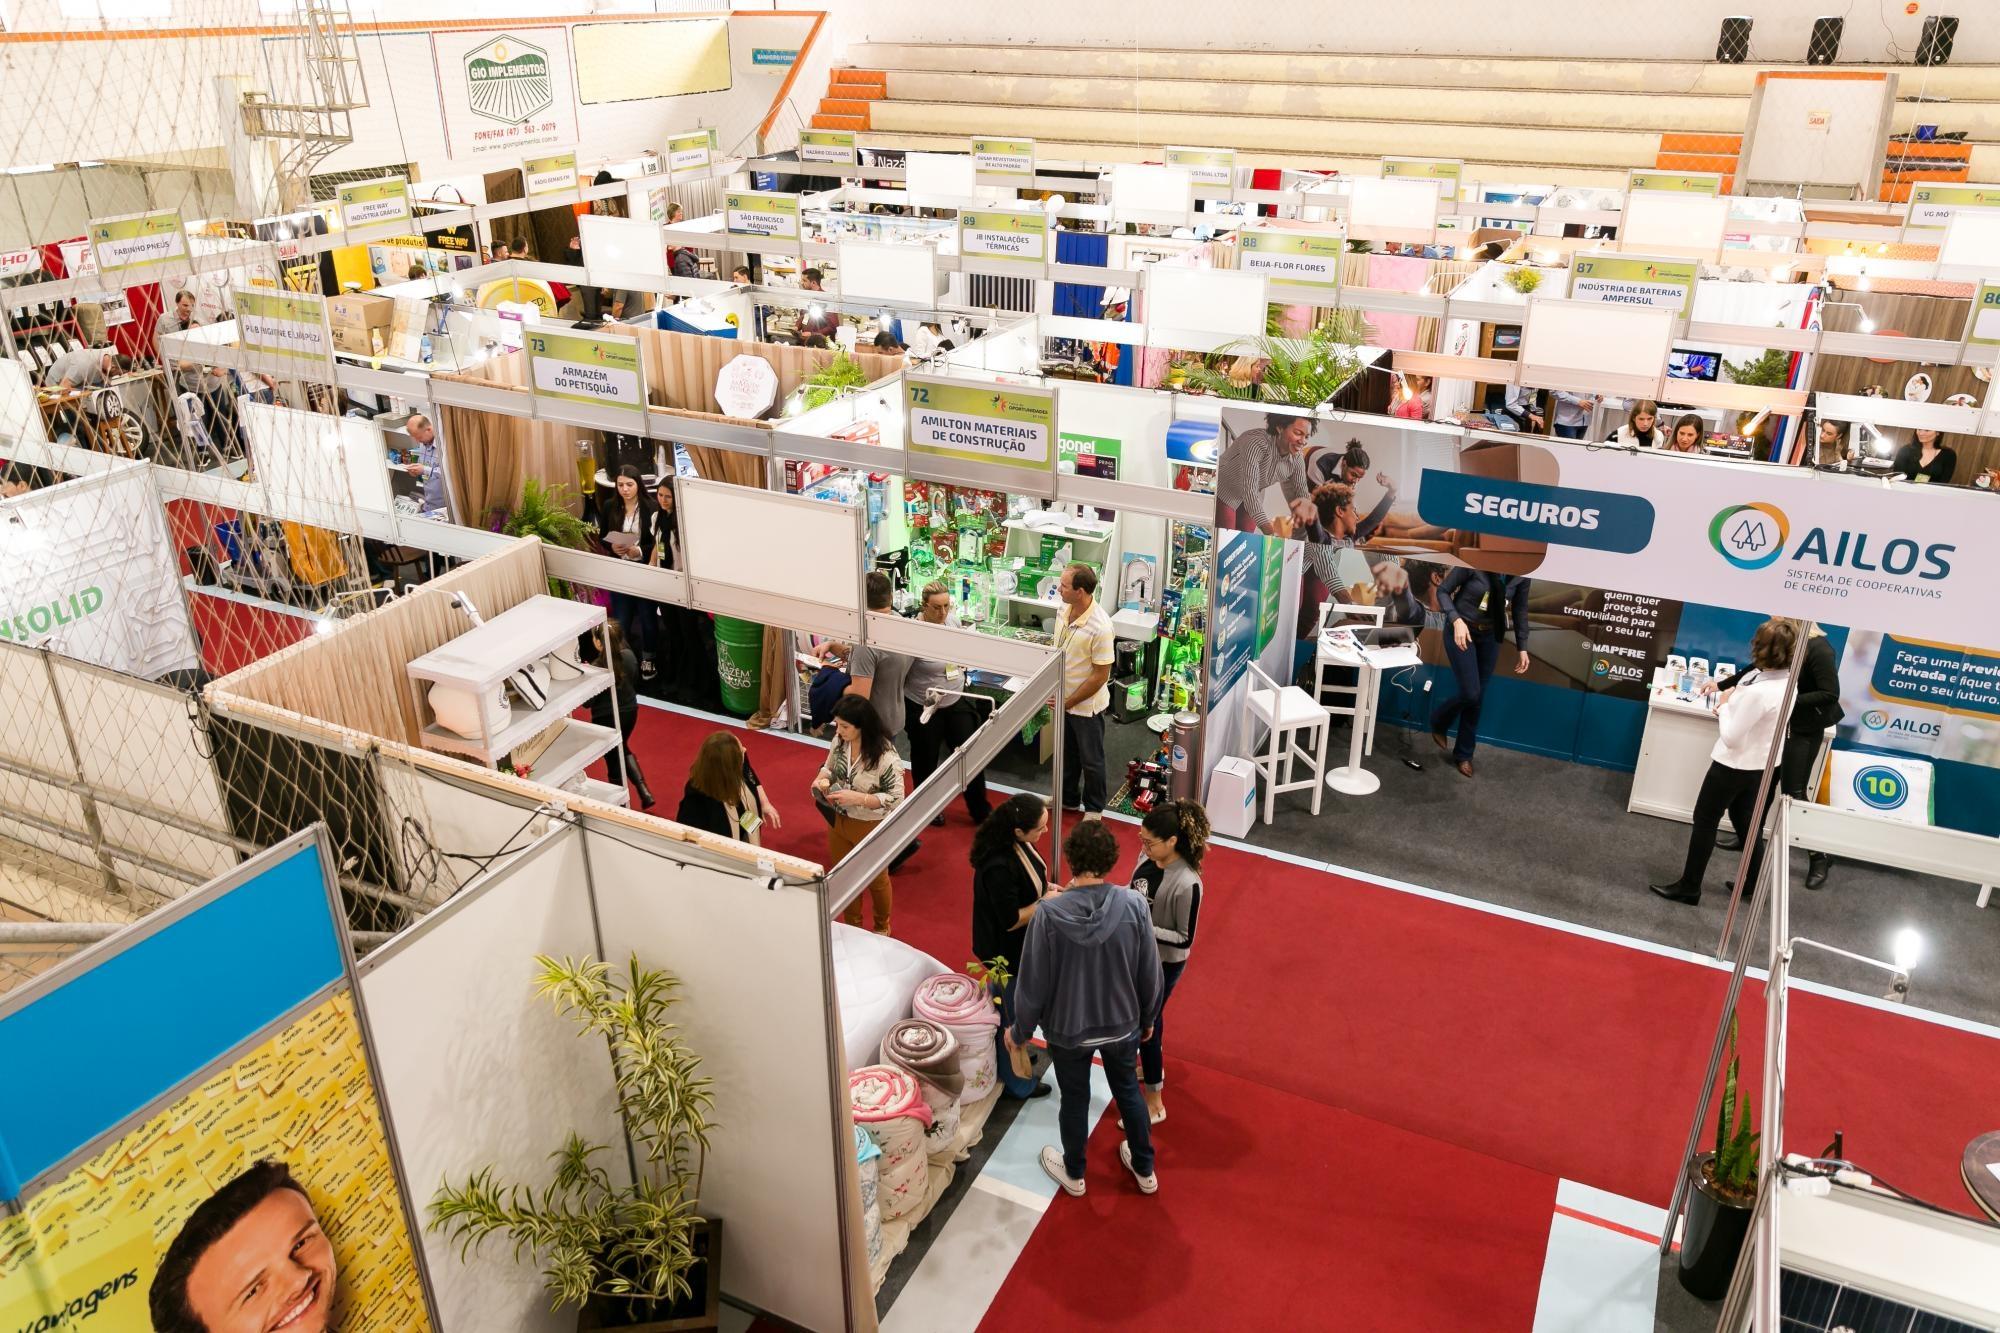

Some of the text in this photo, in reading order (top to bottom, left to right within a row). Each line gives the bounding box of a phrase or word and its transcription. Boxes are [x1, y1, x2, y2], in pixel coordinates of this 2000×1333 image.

[471, 63, 545, 79] GIO IMPLEMENTOS
[474, 129, 504, 140] FONE/FAX
[527, 164, 535, 172] 46
[1385, 165, 1395, 173] 51
[1633, 178, 1645, 187] 52
[343, 193, 353, 202] 45
[728, 199, 739, 207] 90
[1917, 192, 1930, 200] 53
[363, 202, 389, 212] FREE WAY
[351, 207, 402, 222] INDÚSTRIA GRÁFICA
[740, 213, 784, 224] SÃO FRANCISCO
[963, 216, 976, 226] 89
[747, 221, 778, 231] MÁQUINAS
[984, 234, 1029, 245] INSTALAÇÕES
[986, 241, 1020, 252] TÉRMICAS
[1243, 237, 1257, 248] 88
[114, 240, 170, 256] FABINHO PNEUS
[1250, 259, 1326, 273] BEIJA-FLOR FLORES
[1576, 262, 1594, 274] 87
[1578, 281, 1683, 298] INDÚSTRIA DE BATERIAS
[1602, 294, 1654, 306] AMPERSUL
[531, 339, 545, 353] 73
[562, 366, 608, 382] ARMAZÉM
[555, 377, 619, 396] DO PETISQUÃO
[910, 387, 930, 404] 72
[921, 415, 1037, 441] AMILTON MATERIAIS
[932, 430, 1026, 453] DE CONSTRUÇÃO
[1464, 492, 1600, 530] SEGUROS
[1791, 527, 1956, 580] AILOS
[1784, 581, 1848, 598] DE CRÉDITO
[1787, 569, 1942, 599] SISTEMA DE COOPERATIVAS
[1604, 592, 1661, 606] quem quer
[1603, 603, 1658, 617] proteção e
[1630, 618, 1656, 628] para
[1615, 626, 1634, 636] seu
[1636, 627, 1653, 639] lar.
[1592, 643, 1646, 660] MAPFRE
[1897, 651, 1928, 665] Faça
[1931, 658, 1959, 669] uma
[1609, 664, 1644, 679] AILOS
[1892, 664, 1947, 681] Privada
[1950, 675, 1957, 683] e
[1960, 676, 1992, 691] fique
[1889, 679, 1916, 690] com
[1931, 686, 1953, 697] seu
[1956, 689, 2000, 705] futuro.
[1890, 718, 1941, 737] AILOS
[1866, 776, 1897, 797] 10
